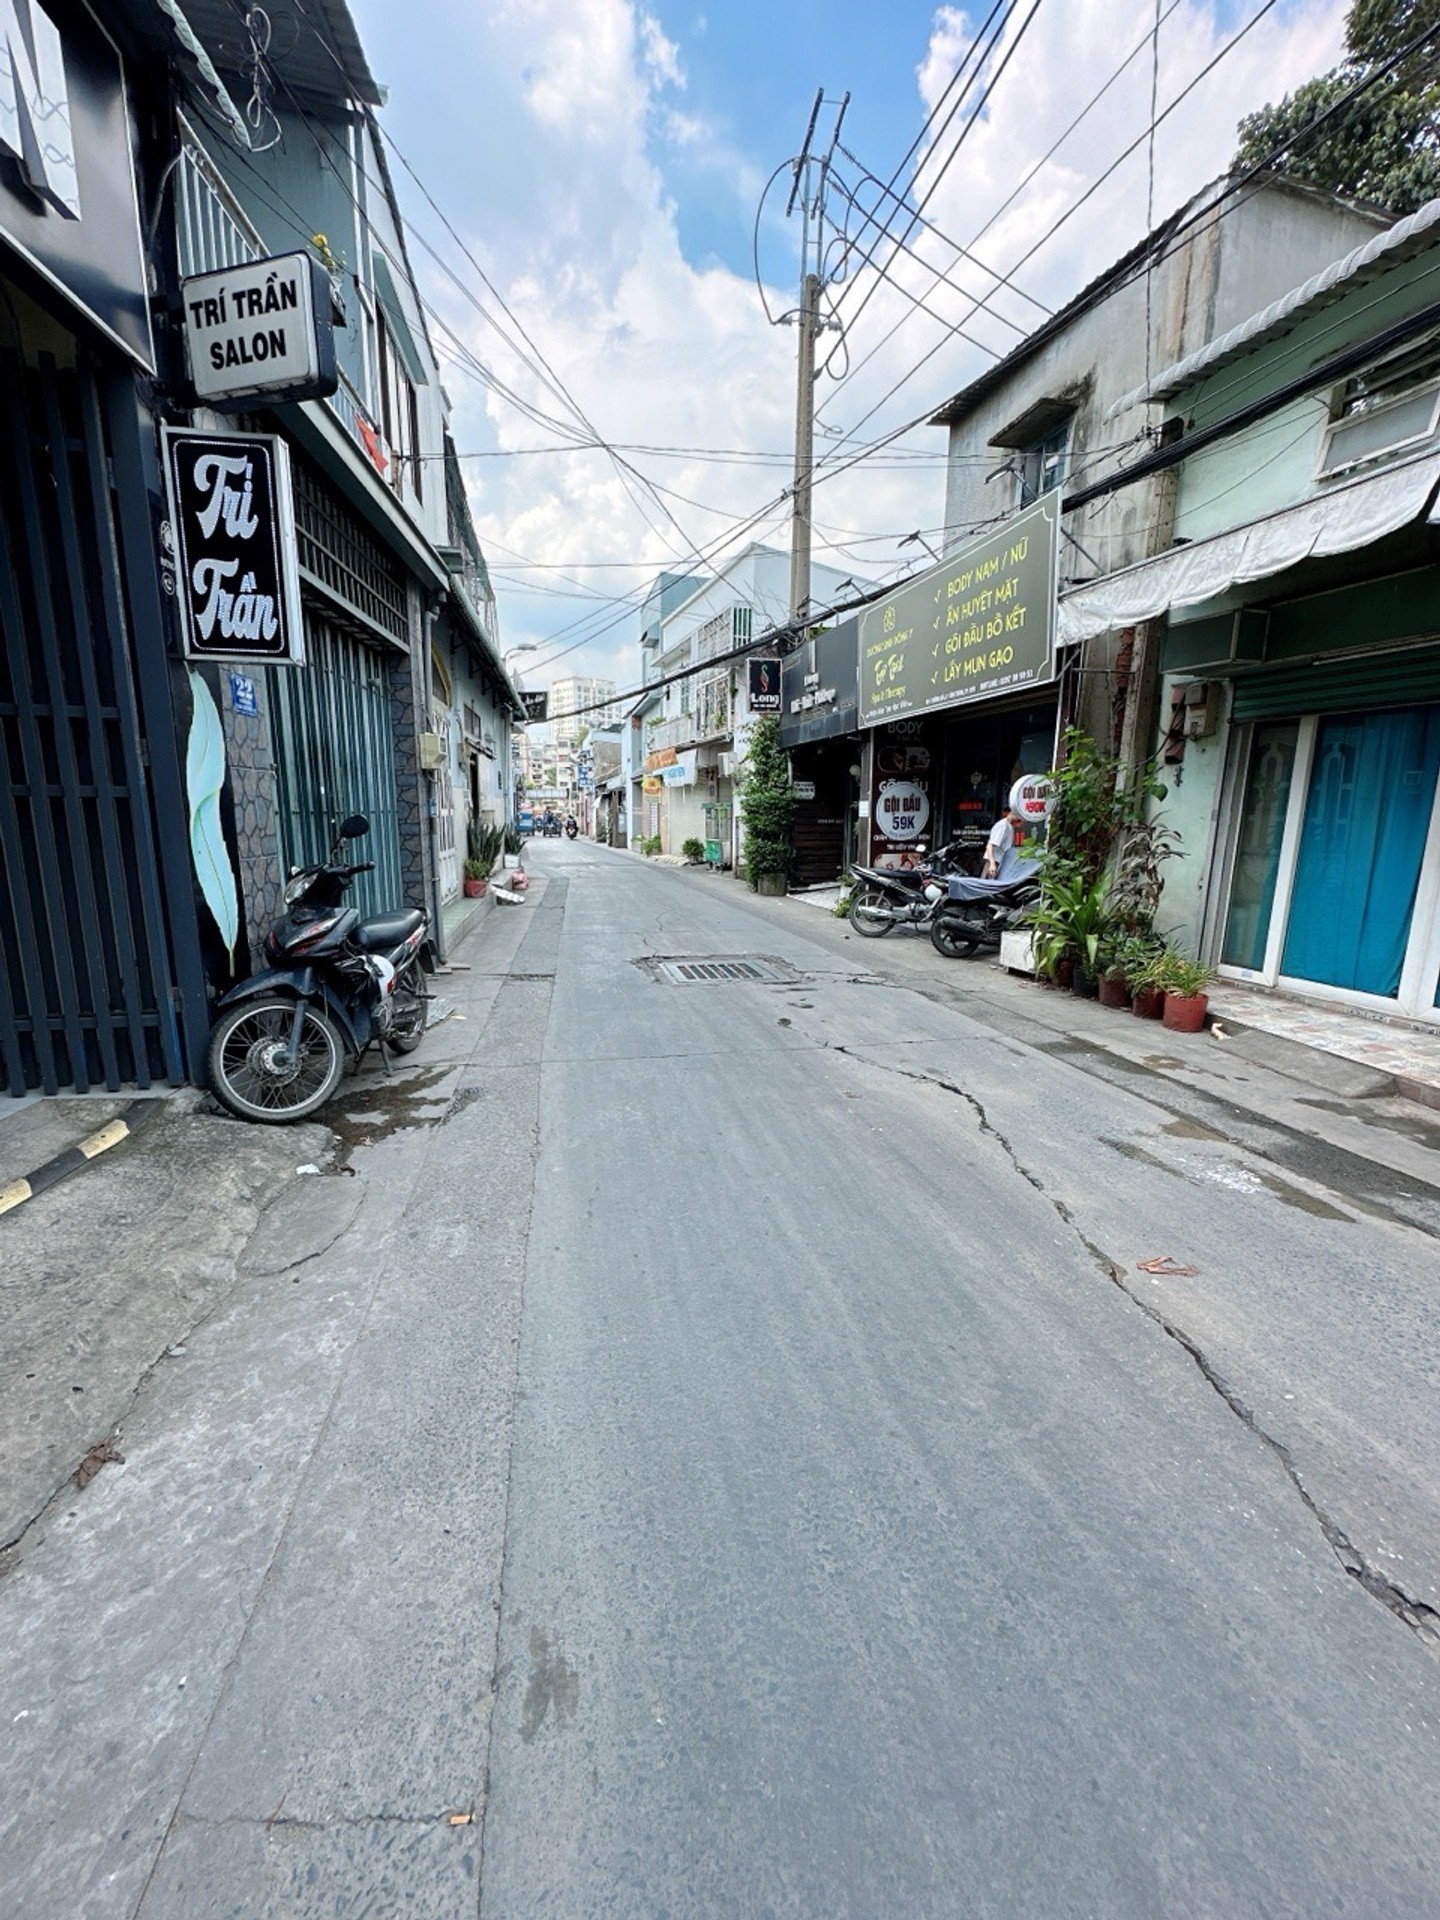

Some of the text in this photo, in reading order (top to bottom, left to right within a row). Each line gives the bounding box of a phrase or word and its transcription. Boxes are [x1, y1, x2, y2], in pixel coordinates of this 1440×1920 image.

[190, 271, 299, 330] TRÍ TRẦN
[210, 327, 287, 370] SALON
[193, 454, 259, 540] Trí
[947, 536, 1029, 598] BODY NAM / NỮ
[192, 557, 279, 641] Trần
[961, 589, 993, 620] HUYỆT
[995, 577, 1020, 605] MẶT
[945, 602, 1028, 656] GỘI ĐẦU BỒ KẾT
[943, 645, 1014, 683] LẤY MỤN GẠO
[235, 677, 253, 700] 22
[751, 693, 780, 705] Long
[887, 720, 925, 736] BODY
[883, 794, 900, 815] GỘI
[892, 815, 915, 831] 59K
